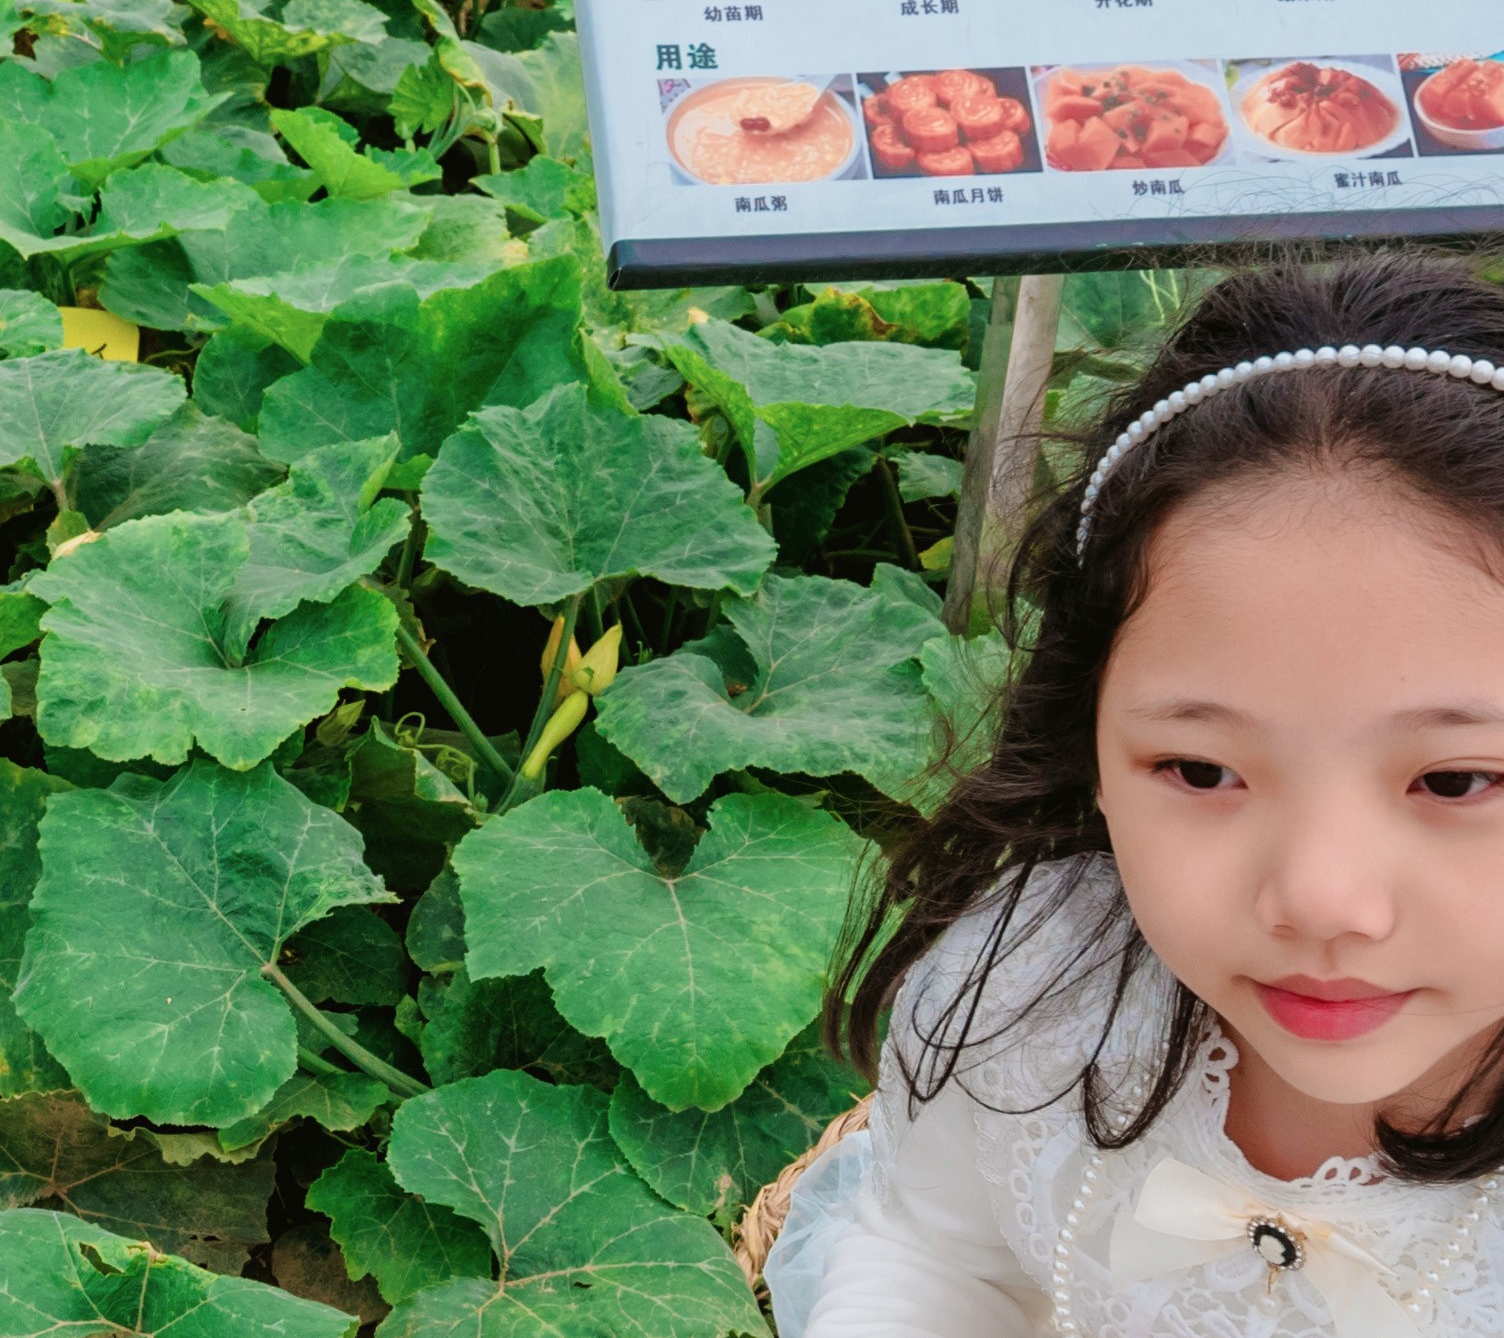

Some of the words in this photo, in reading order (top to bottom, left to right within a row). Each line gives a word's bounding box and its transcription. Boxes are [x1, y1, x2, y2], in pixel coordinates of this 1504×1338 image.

[704, 5, 764, 22] 幼苗期
[656, 42, 719, 71] 用途
[1132, 178, 1186, 196] 炒南瓜
[1333, 170, 1403, 188] 蜜汁南瓜
[735, 195, 788, 213] 南瓜粥
[933, 187, 1004, 205] 南瓜月饼
